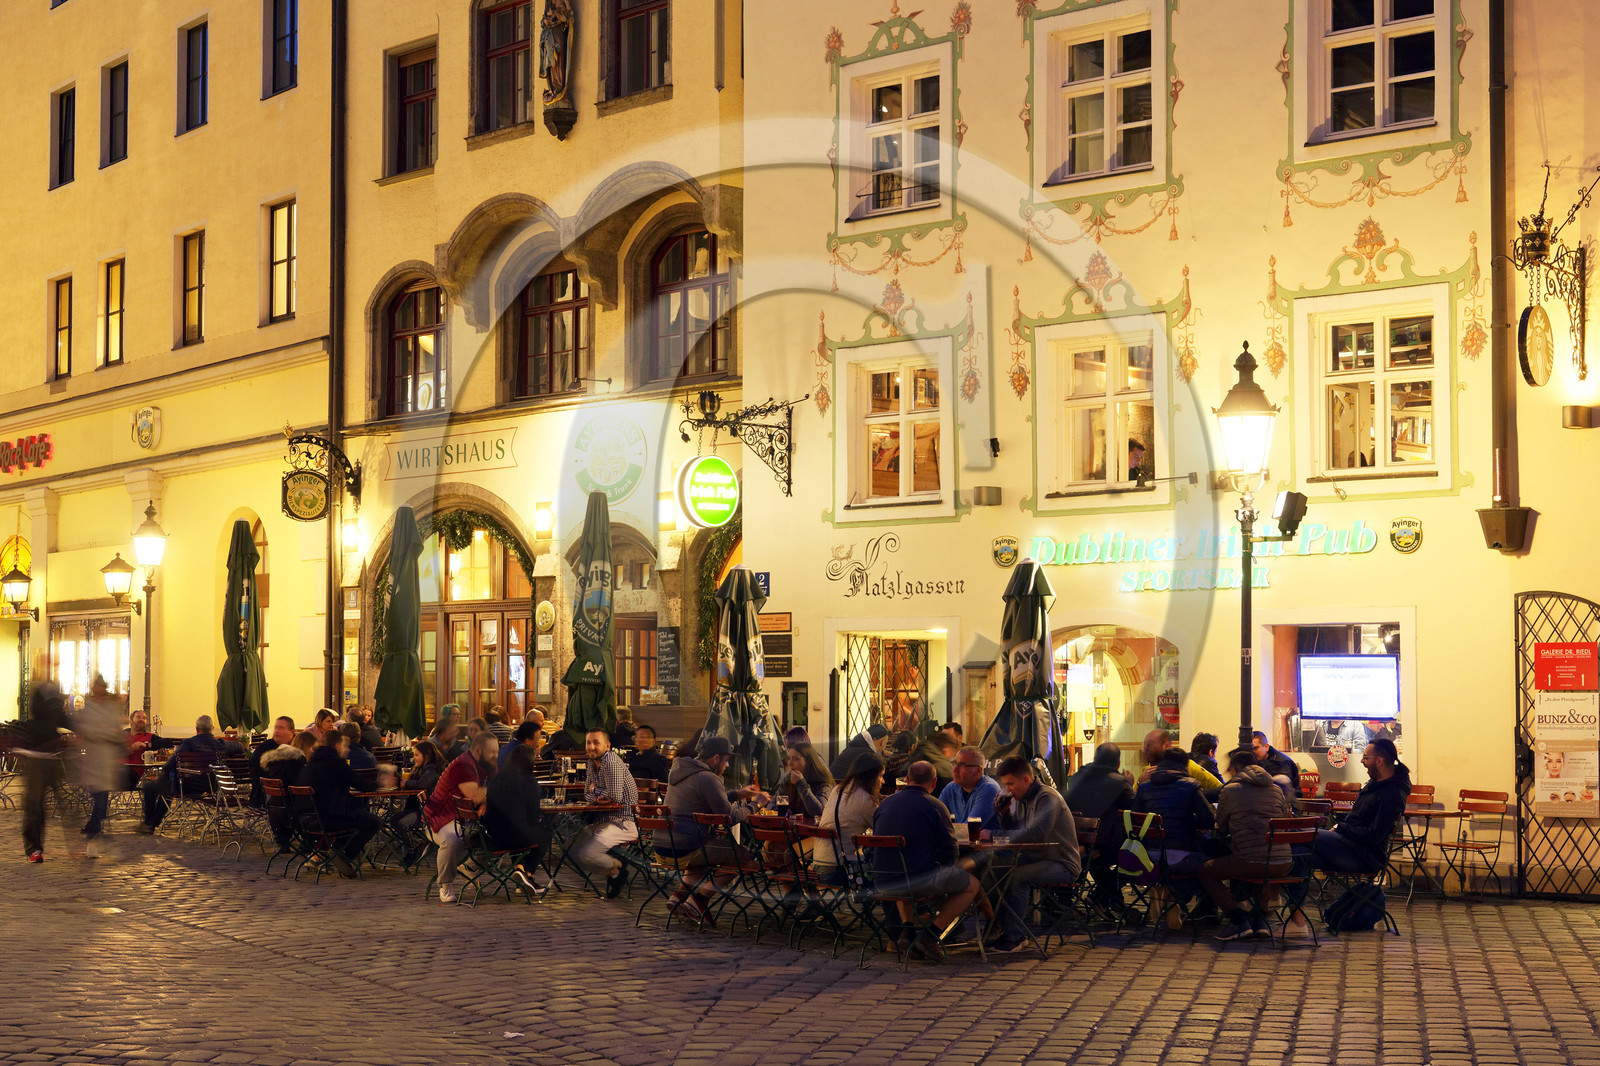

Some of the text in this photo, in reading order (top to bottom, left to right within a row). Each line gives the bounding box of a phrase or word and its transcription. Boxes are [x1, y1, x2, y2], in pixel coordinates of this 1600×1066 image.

[397, 438, 505, 470] WIRTSHAUS
[291, 474, 322, 486] Ayinger
[1391, 519, 1419, 528] Ayinger
[995, 538, 1017, 546] Ayinger
[1030, 520, 1378, 566] Dubliner Irih Pub
[758, 573, 765, 585] 2
[840, 552, 966, 600] Platzlgassen
